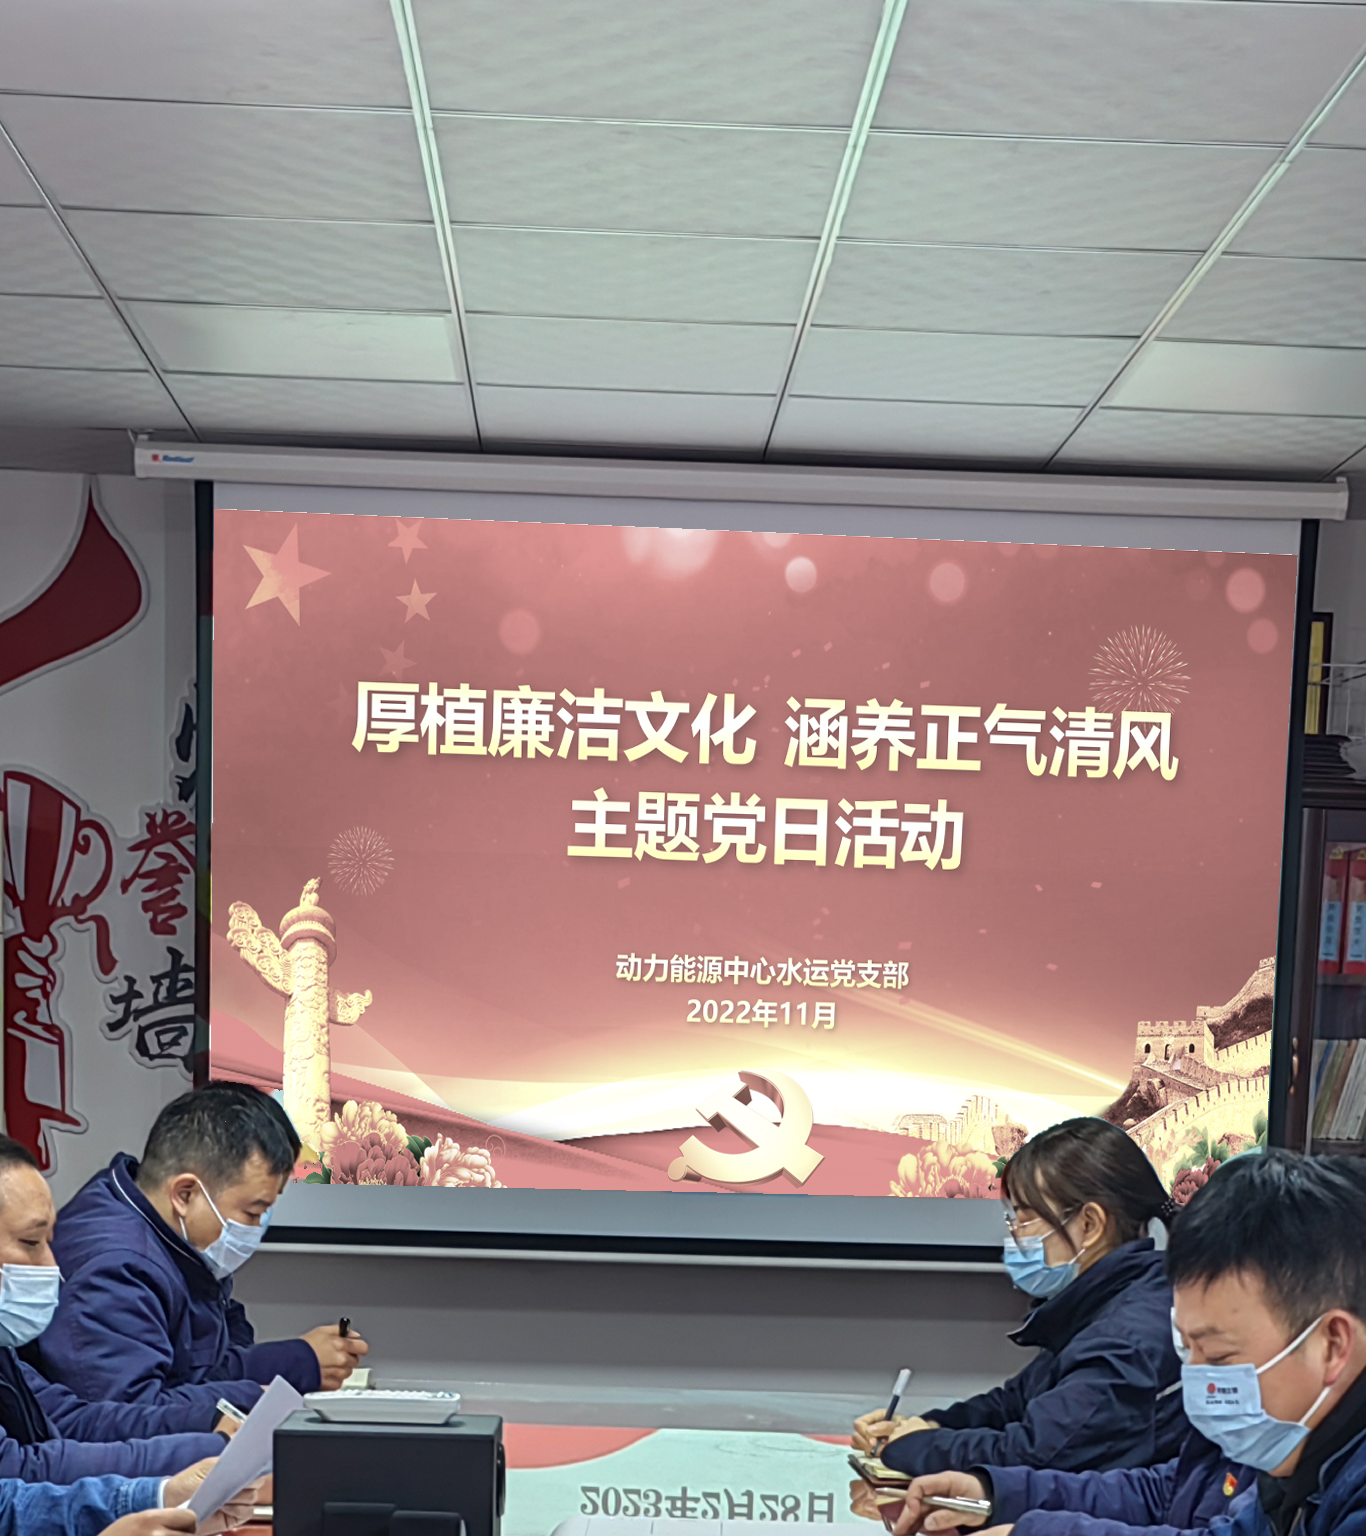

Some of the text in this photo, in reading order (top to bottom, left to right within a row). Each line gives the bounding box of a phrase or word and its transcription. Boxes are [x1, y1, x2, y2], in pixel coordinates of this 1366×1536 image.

[351, 680, 1179, 783] 厚植廉洁文化 涵养正气清风
[567, 790, 966, 871] 主题党日活动
[614, 950, 910, 990] 动力能源中心水运党支部
[685, 998, 837, 1031] 2022年11月
